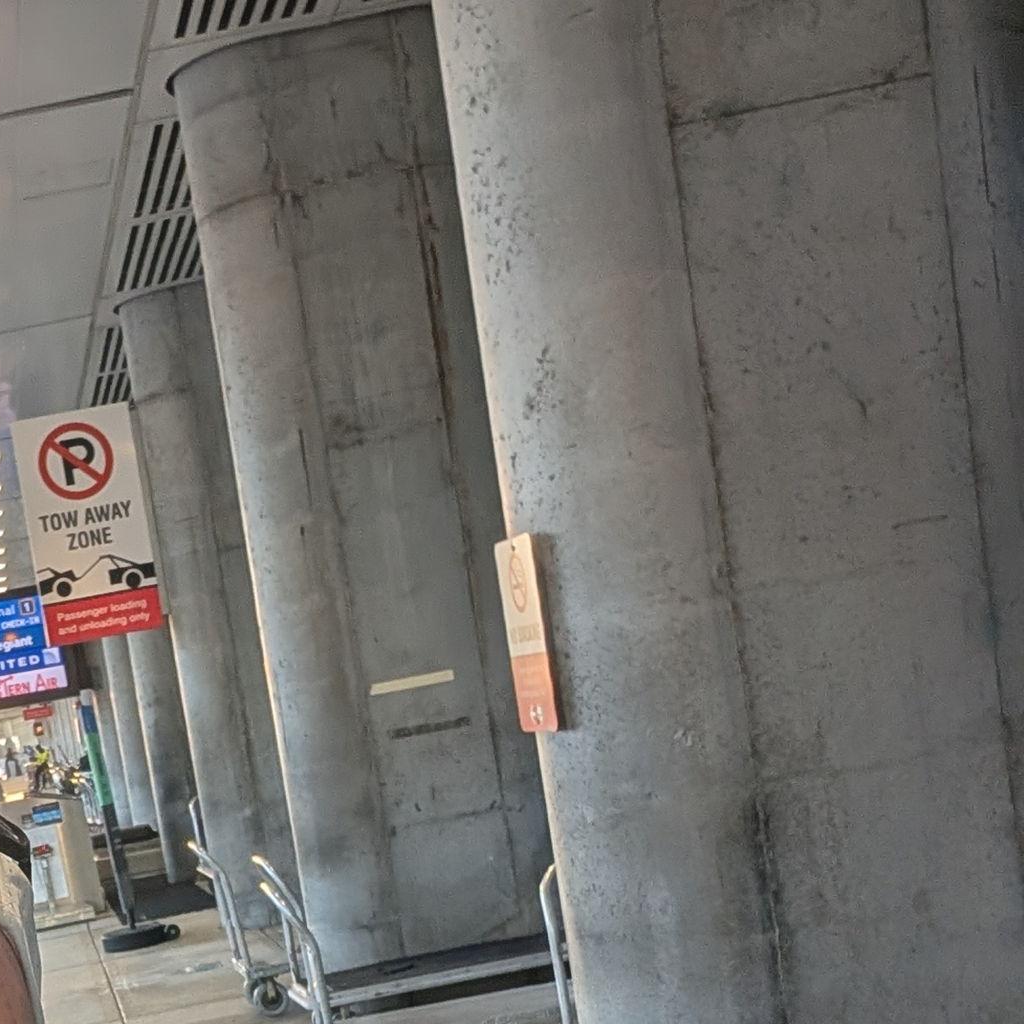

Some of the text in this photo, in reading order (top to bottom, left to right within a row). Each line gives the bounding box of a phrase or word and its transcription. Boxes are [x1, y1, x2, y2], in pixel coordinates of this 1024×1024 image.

[38, 500, 131, 532] TOW AWAY
[67, 527, 113, 551] ZONE
[56, 599, 148, 622] Passenger loading
[57, 611, 150, 636] and unloading only
